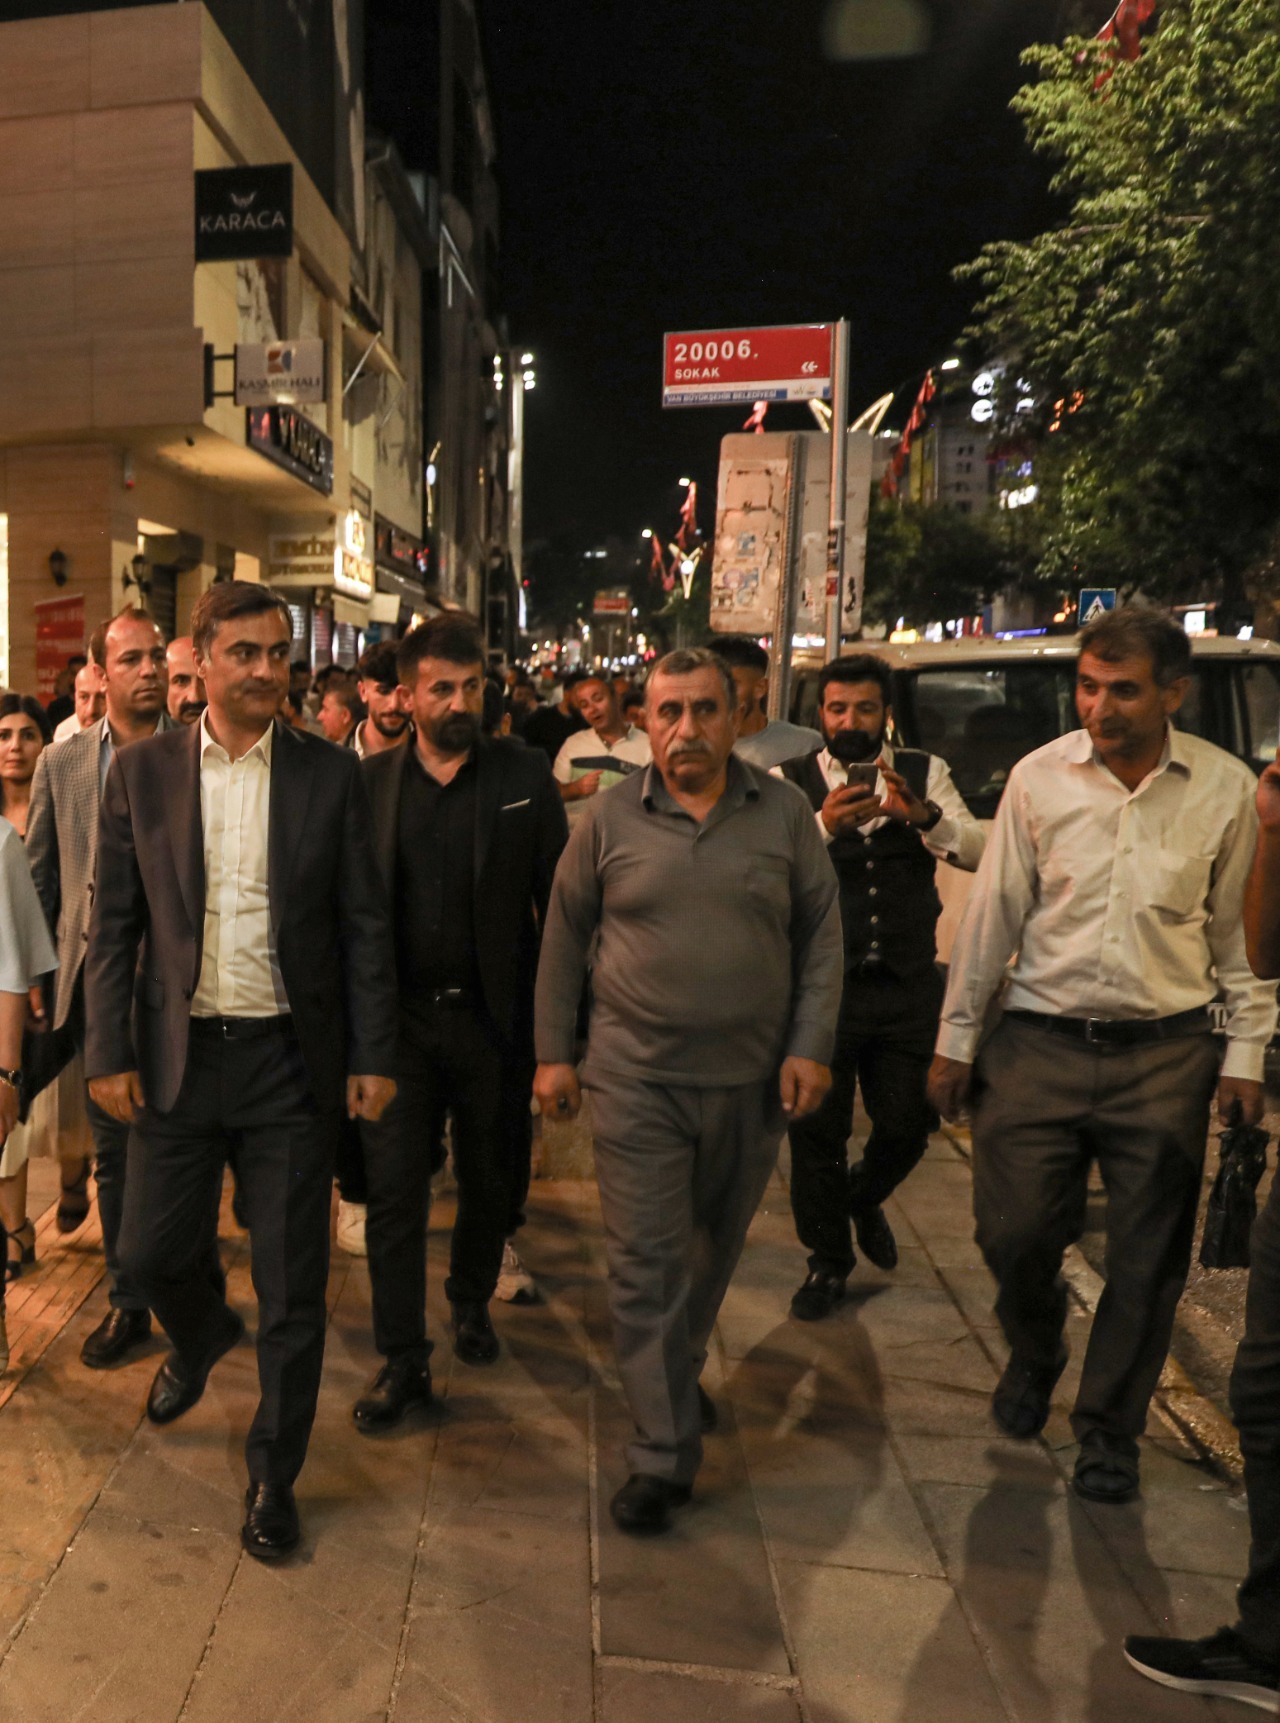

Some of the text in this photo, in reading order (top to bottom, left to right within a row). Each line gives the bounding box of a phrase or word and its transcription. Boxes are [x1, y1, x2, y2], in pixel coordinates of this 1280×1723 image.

[199, 210, 286, 233] KARACA
[674, 339, 759, 363] 20006.
[674, 367, 720, 380] SOKAK
